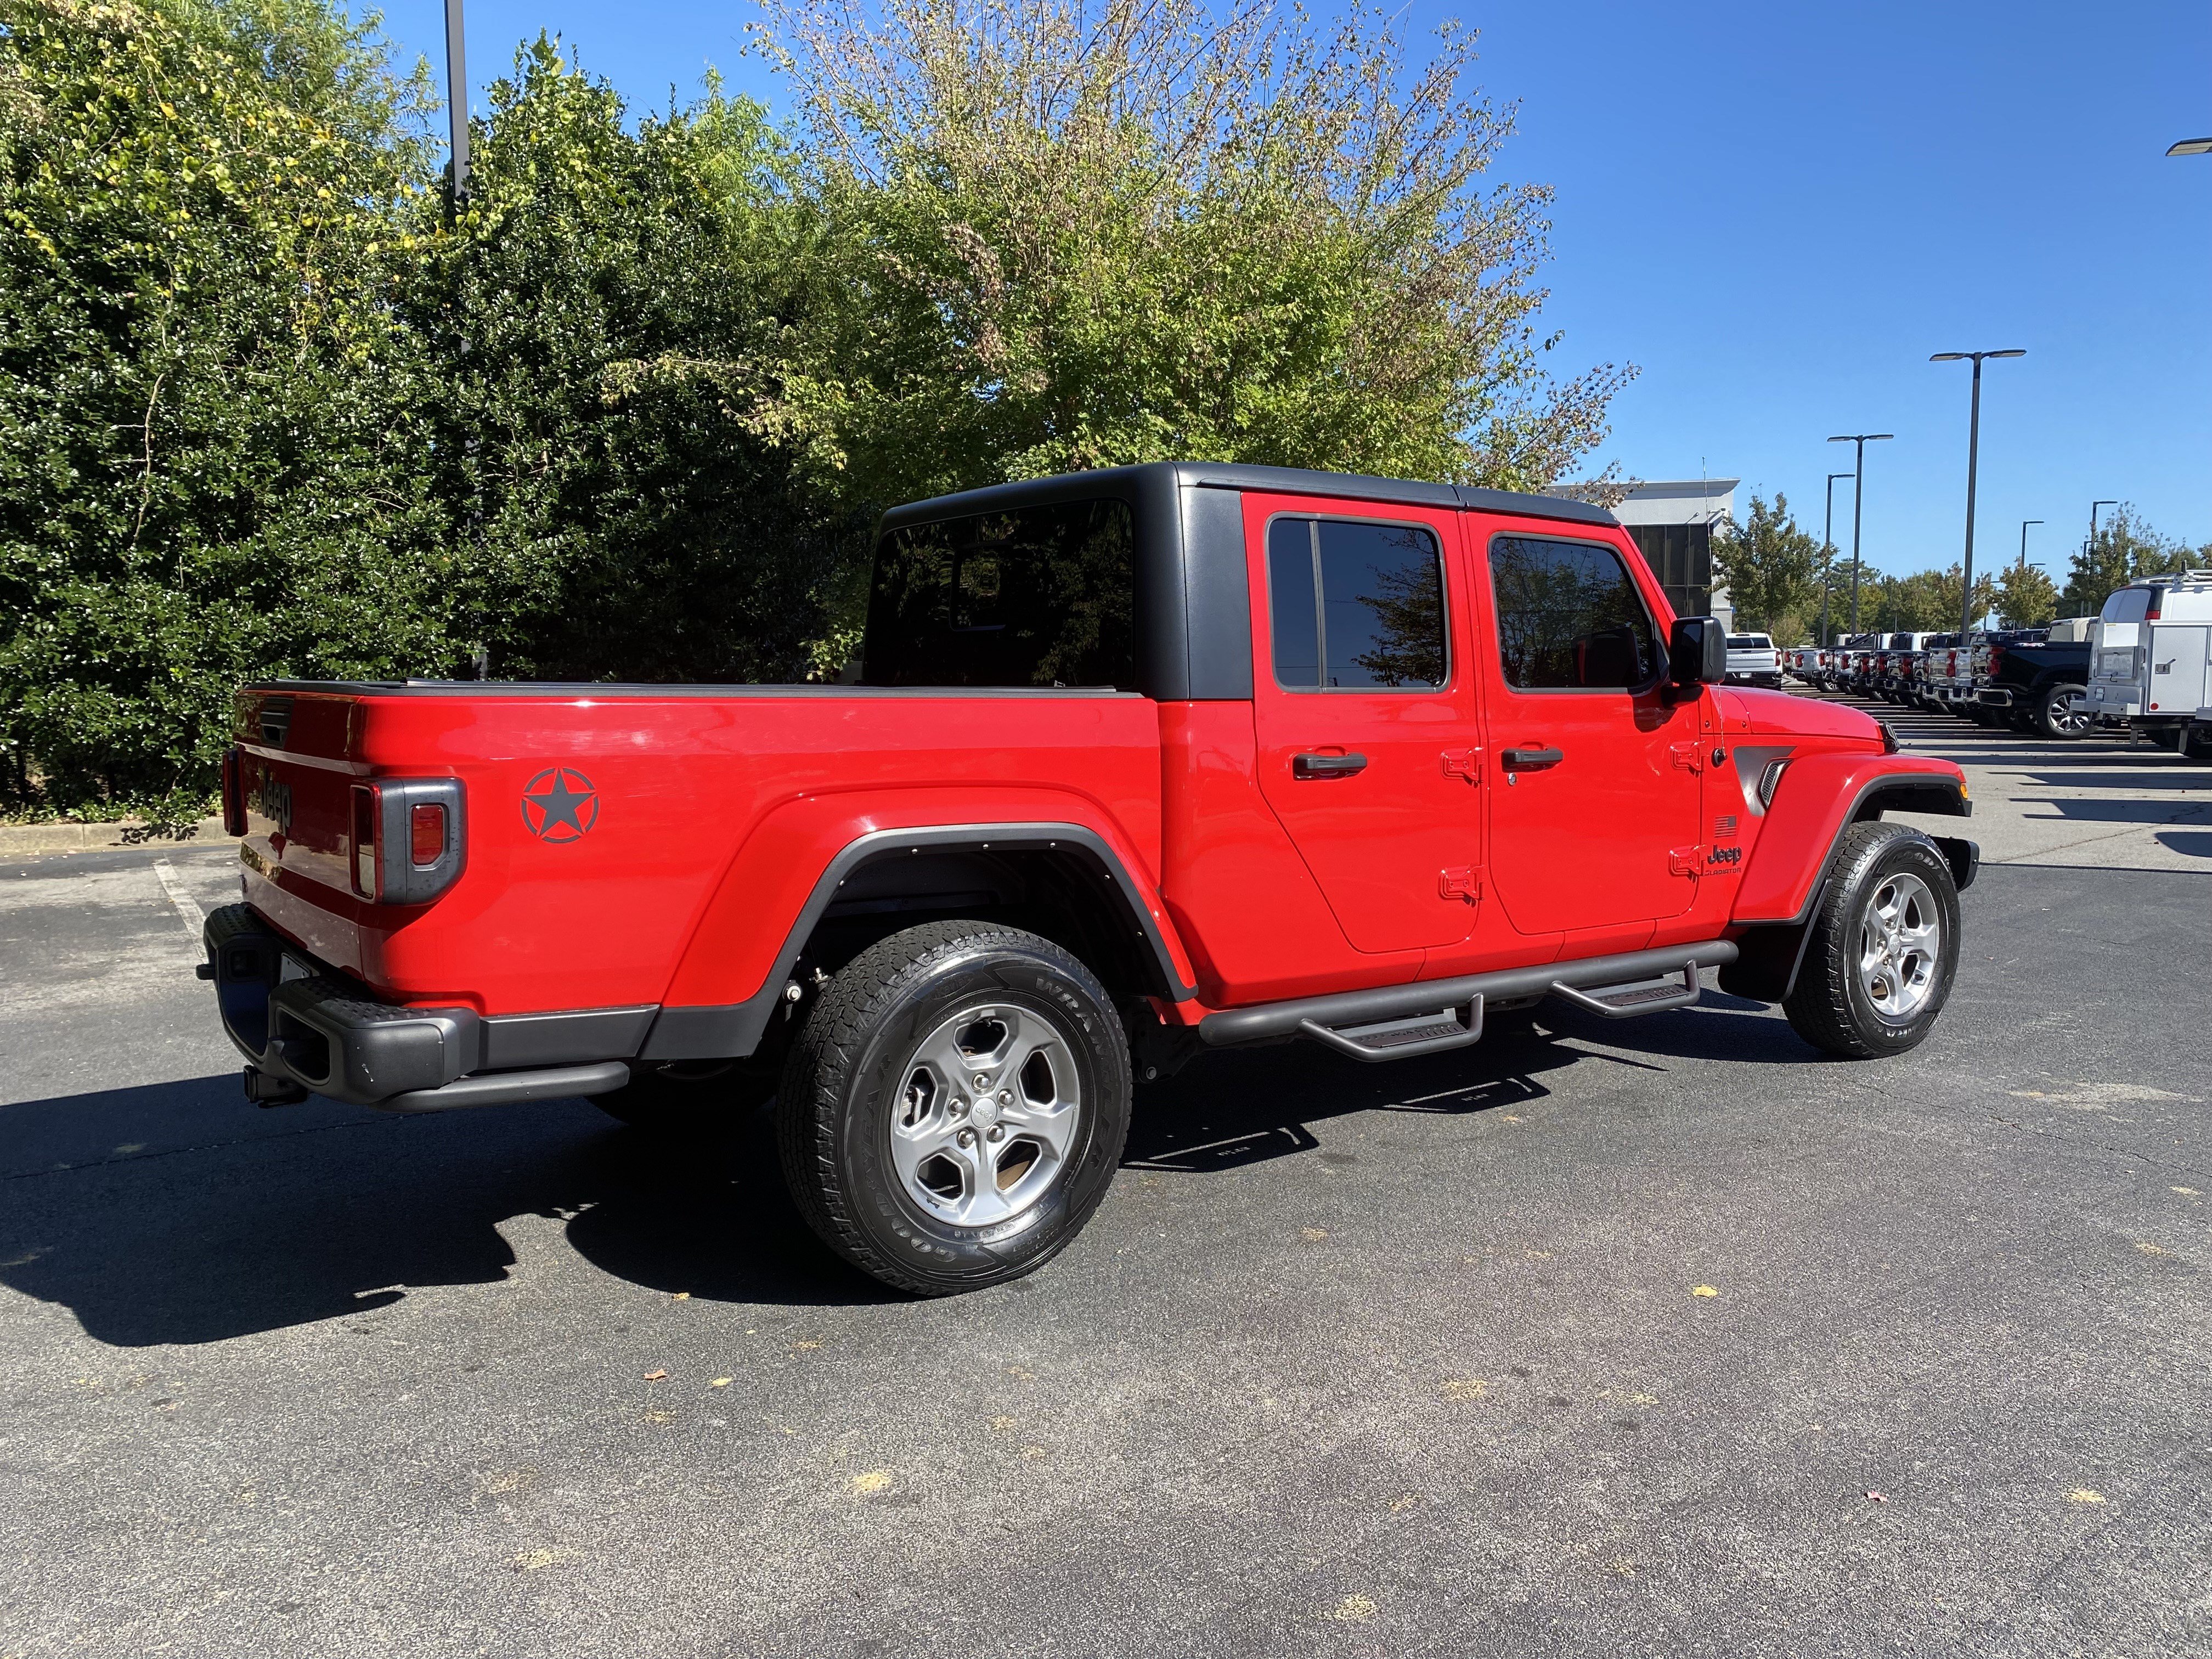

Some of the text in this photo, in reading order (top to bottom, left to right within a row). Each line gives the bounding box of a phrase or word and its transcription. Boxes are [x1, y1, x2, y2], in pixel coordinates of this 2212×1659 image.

[261, 766, 291, 836] Jeep
[1705, 867, 1741, 876] GLADIATOR
[1708, 844, 1741, 866] Jeep
[1035, 976, 1115, 1169] WRANGLER
[862, 1053, 957, 1262] GOODYEAR
